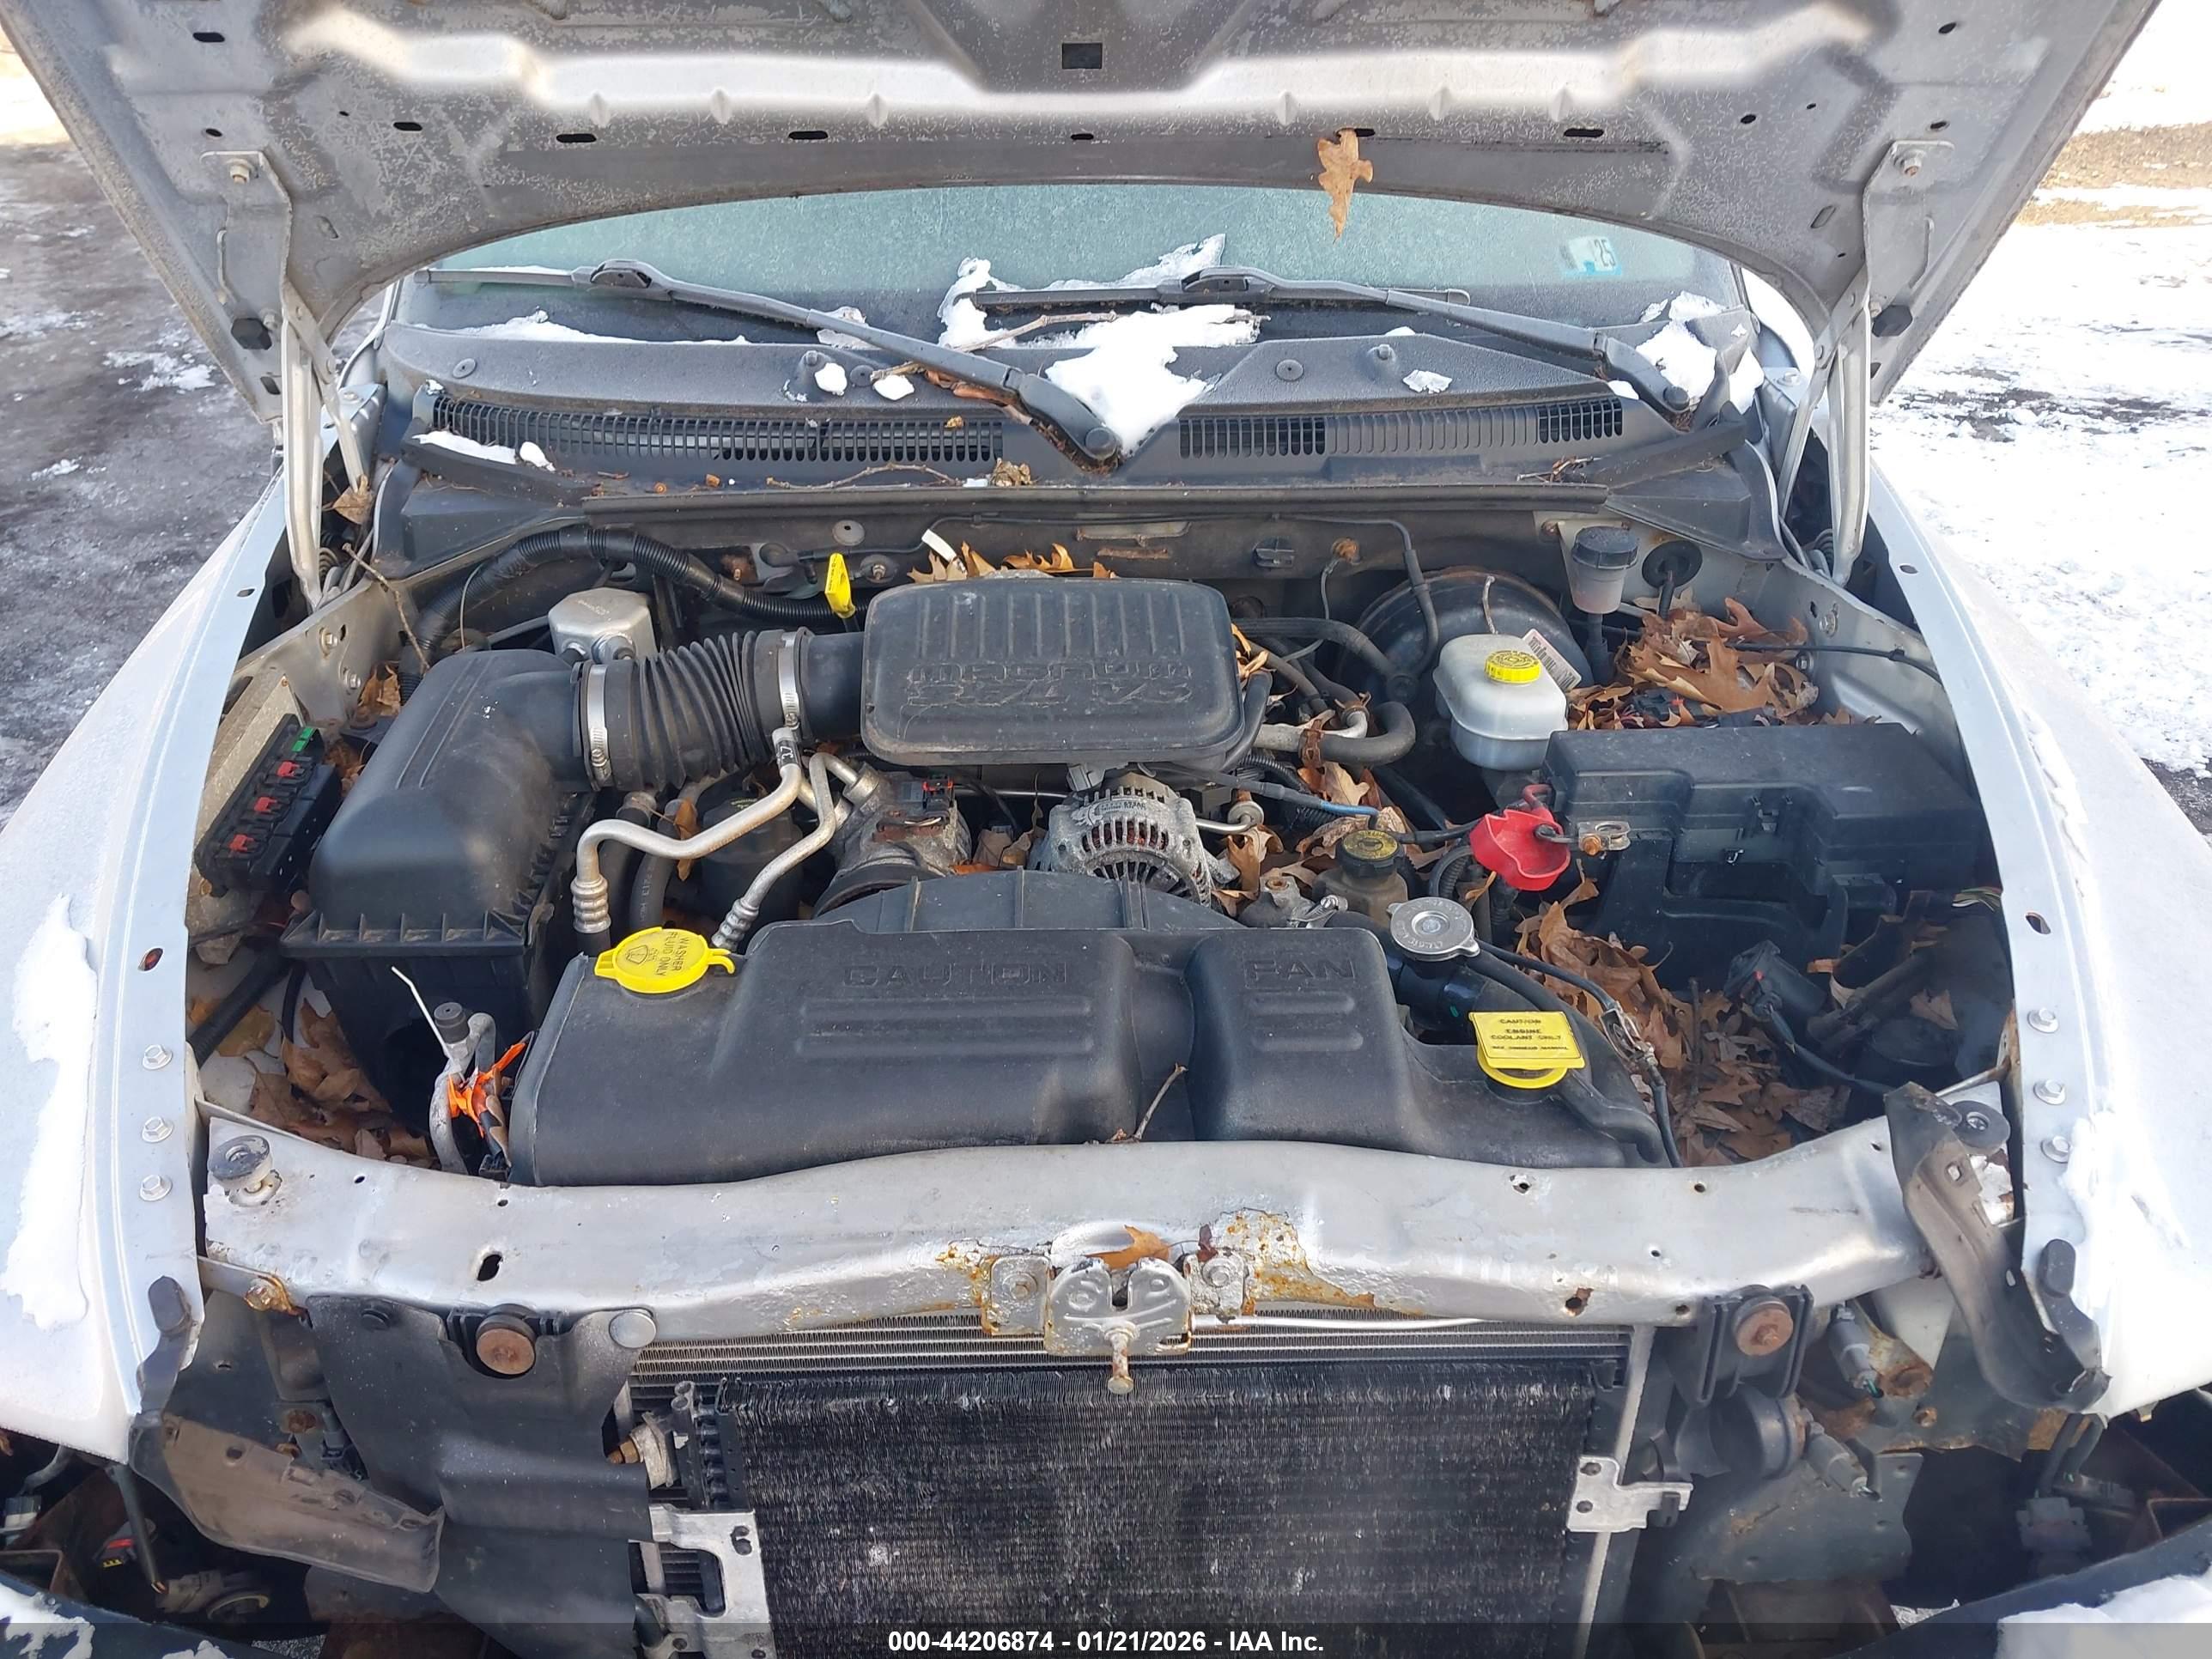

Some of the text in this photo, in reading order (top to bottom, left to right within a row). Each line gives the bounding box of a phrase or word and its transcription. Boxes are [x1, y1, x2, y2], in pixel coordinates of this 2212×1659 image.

[1593, 238, 1616, 267] 25
[655, 931, 678, 977] FLUID ONLY
[672, 936, 690, 972] WASHER
[842, 958, 1357, 987] CAUTION FAN
